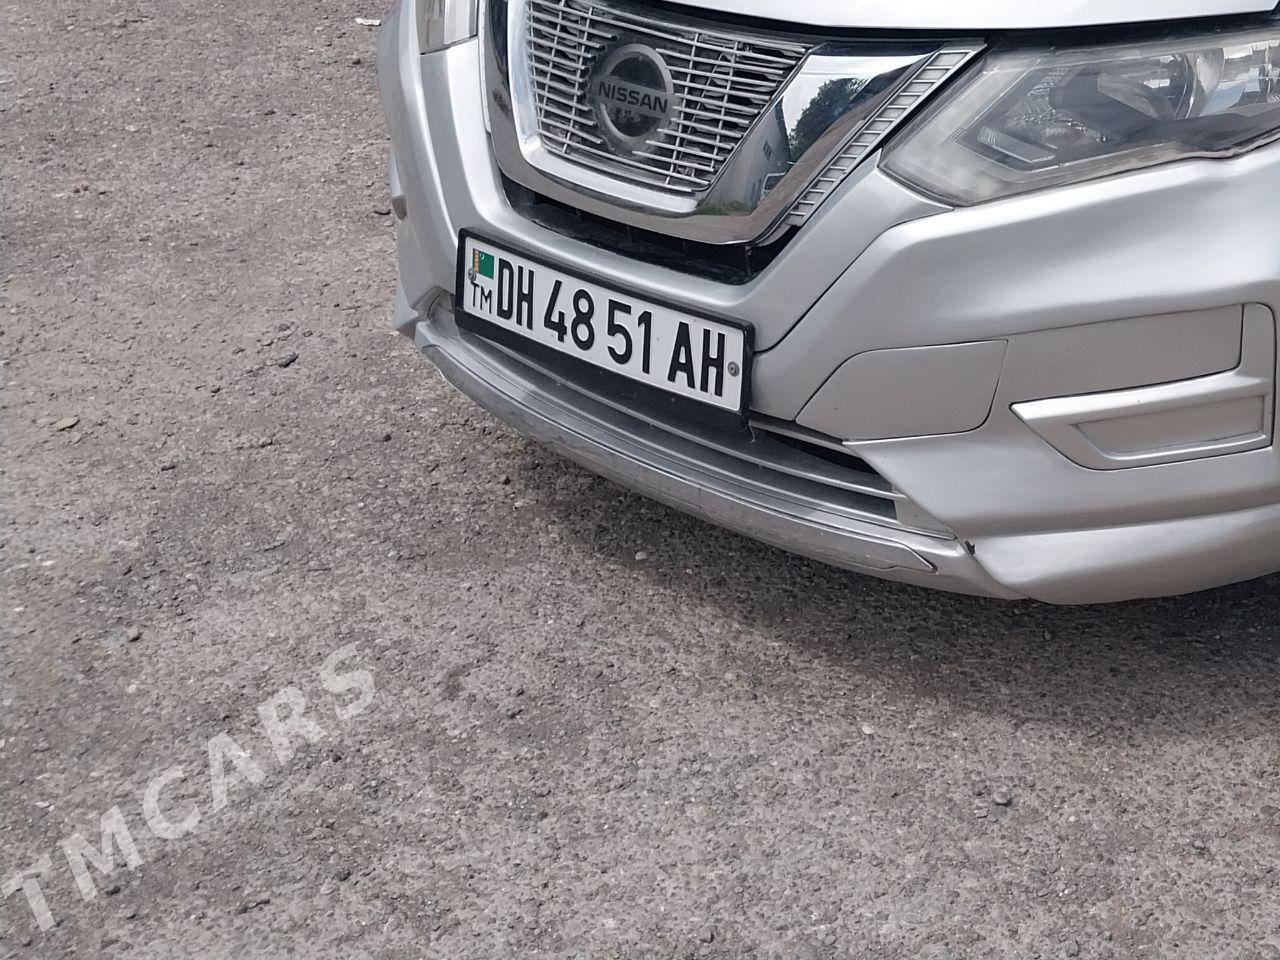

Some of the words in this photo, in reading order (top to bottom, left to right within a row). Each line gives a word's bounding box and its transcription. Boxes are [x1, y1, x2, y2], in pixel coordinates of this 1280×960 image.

[598, 81, 668, 113] NISSAN
[470, 281, 492, 314] TM
[496, 257, 535, 331] DH
[667, 320, 726, 397] AH
